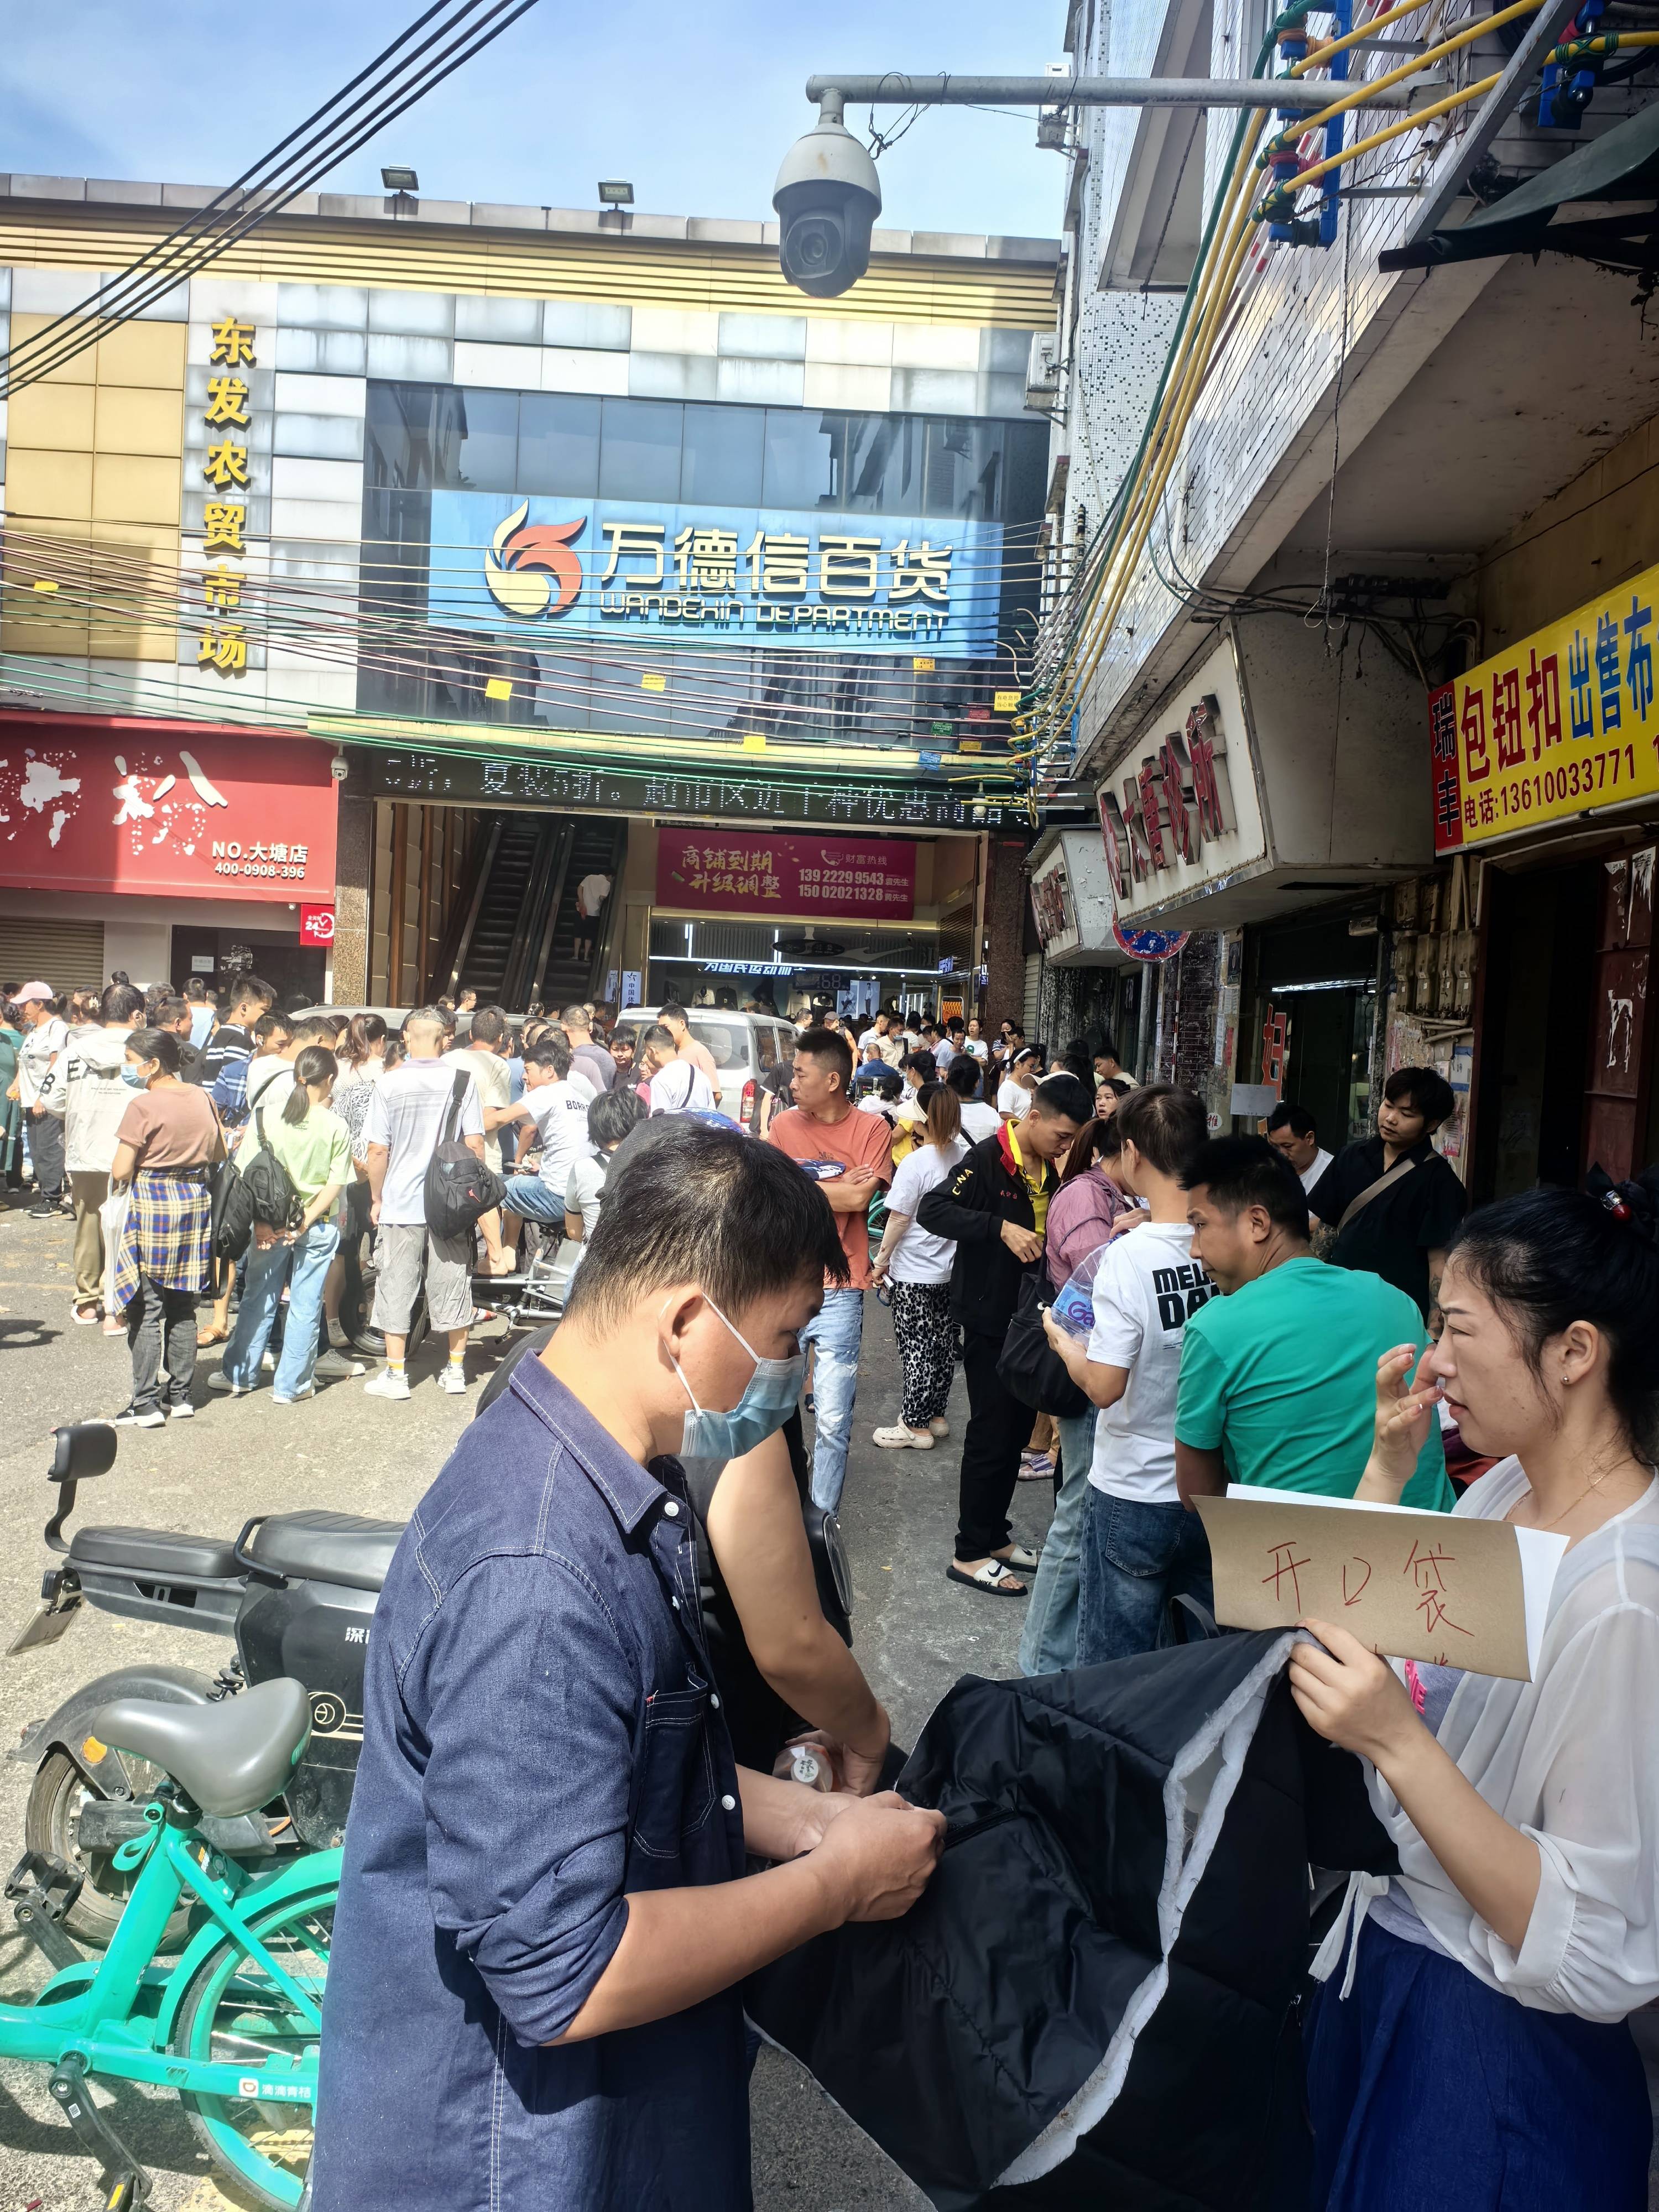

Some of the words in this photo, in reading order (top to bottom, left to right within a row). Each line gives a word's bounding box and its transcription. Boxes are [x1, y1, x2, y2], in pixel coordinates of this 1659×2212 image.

[196, 316, 257, 671] 东发农贸市场
[601, 522, 953, 601] 万德信百货
[756, 602, 950, 635] DEPARTMENT
[1432, 691, 1460, 837] 瑞丰
[212, 841, 308, 864] NO.大塘店
[681, 845, 772, 874] 商铺到期
[845, 854, 888, 866] 财富热线
[215, 862, 305, 879] 400-0908-396
[799, 868, 821, 882] 139
[822, 869, 853, 884] 2229
[855, 872, 884, 885] 9543
[689, 871, 782, 898] 升级调整
[799, 884, 820, 898] 150
[822, 885, 852, 900] 0202
[854, 887, 883, 901] 1328
[305, 921, 319, 931] 24
[345, 1627, 371, 1644] 深
[262, 2083, 311, 2099] 滴滴青桔
